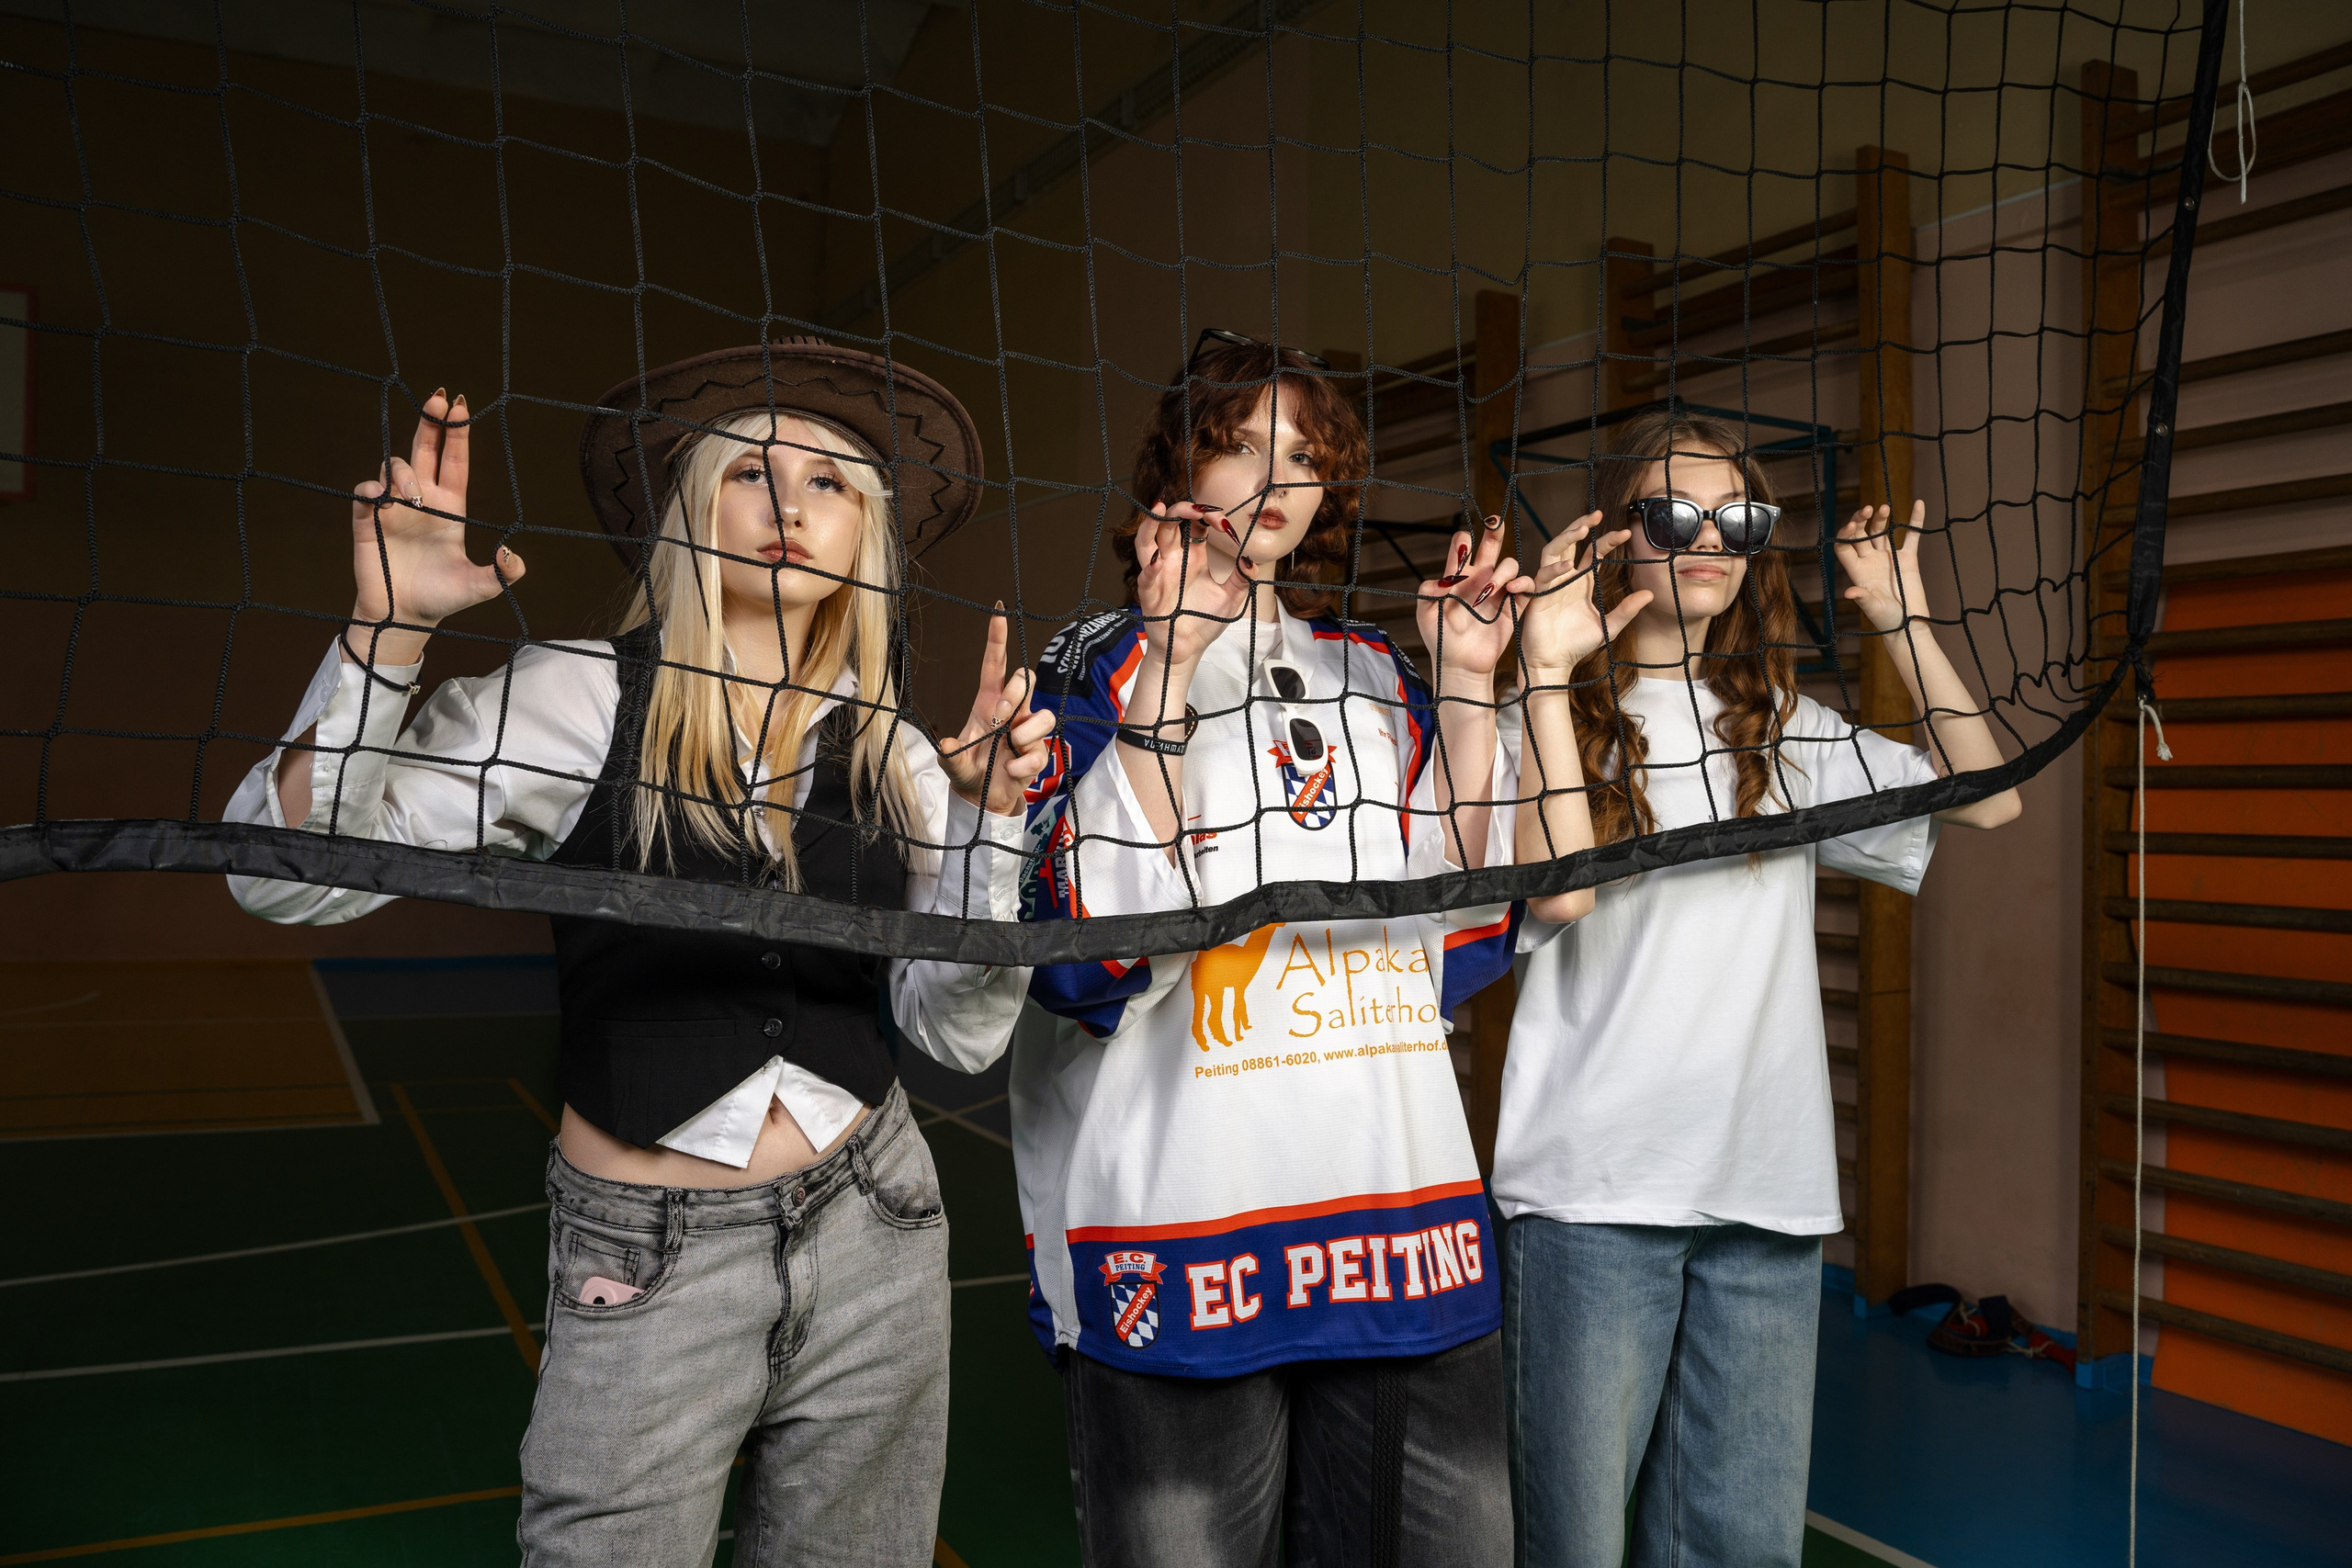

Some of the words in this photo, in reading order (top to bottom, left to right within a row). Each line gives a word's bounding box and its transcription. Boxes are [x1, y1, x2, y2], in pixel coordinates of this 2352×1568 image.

[1275, 925, 1429, 994] Alpaka
[1288, 985, 1438, 1038] Saliterho
[1194, 1061, 1239, 1078] Peiting
[1241, 1051, 1321, 1072] 08861-6020,
[1323, 1039, 1450, 1062] www.alpakasaliterhof.d
[1113, 1253, 1147, 1264] E.C.
[1114, 1263, 1146, 1272] PEITING
[1184, 1252, 1262, 1331] EC
[1283, 1218, 1484, 1310] PEITING
[1119, 1287, 1153, 1334] Eishockey
